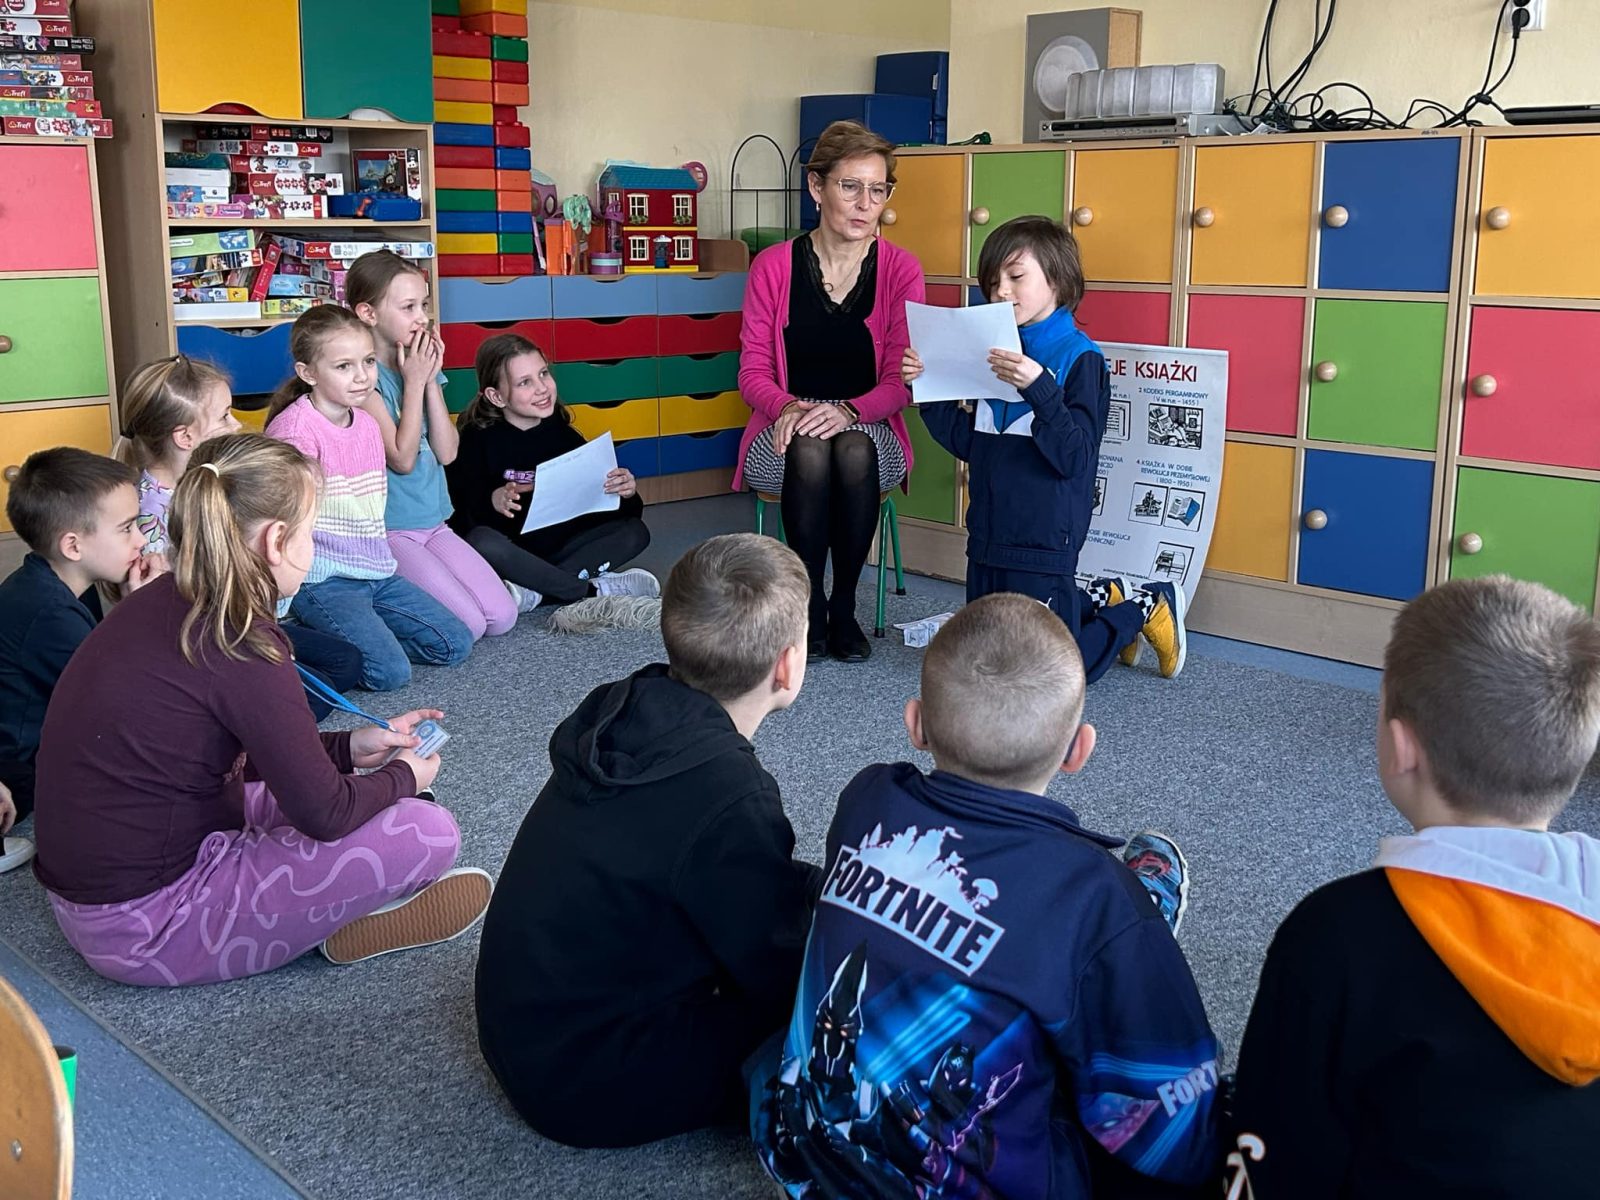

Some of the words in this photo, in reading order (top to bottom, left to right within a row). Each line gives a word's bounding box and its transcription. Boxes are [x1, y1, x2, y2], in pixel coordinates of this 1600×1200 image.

[75, 75, 89, 83] Trefl
[11, 89, 26, 97] Trefl
[16, 120, 31, 128] Trefl
[1135, 360, 1197, 383] KSIĄŻKI
[1143, 387, 1164, 395] KODEKS
[1165, 389, 1209, 399] PERGAMINOWY
[824, 850, 997, 968] FORTNITE
